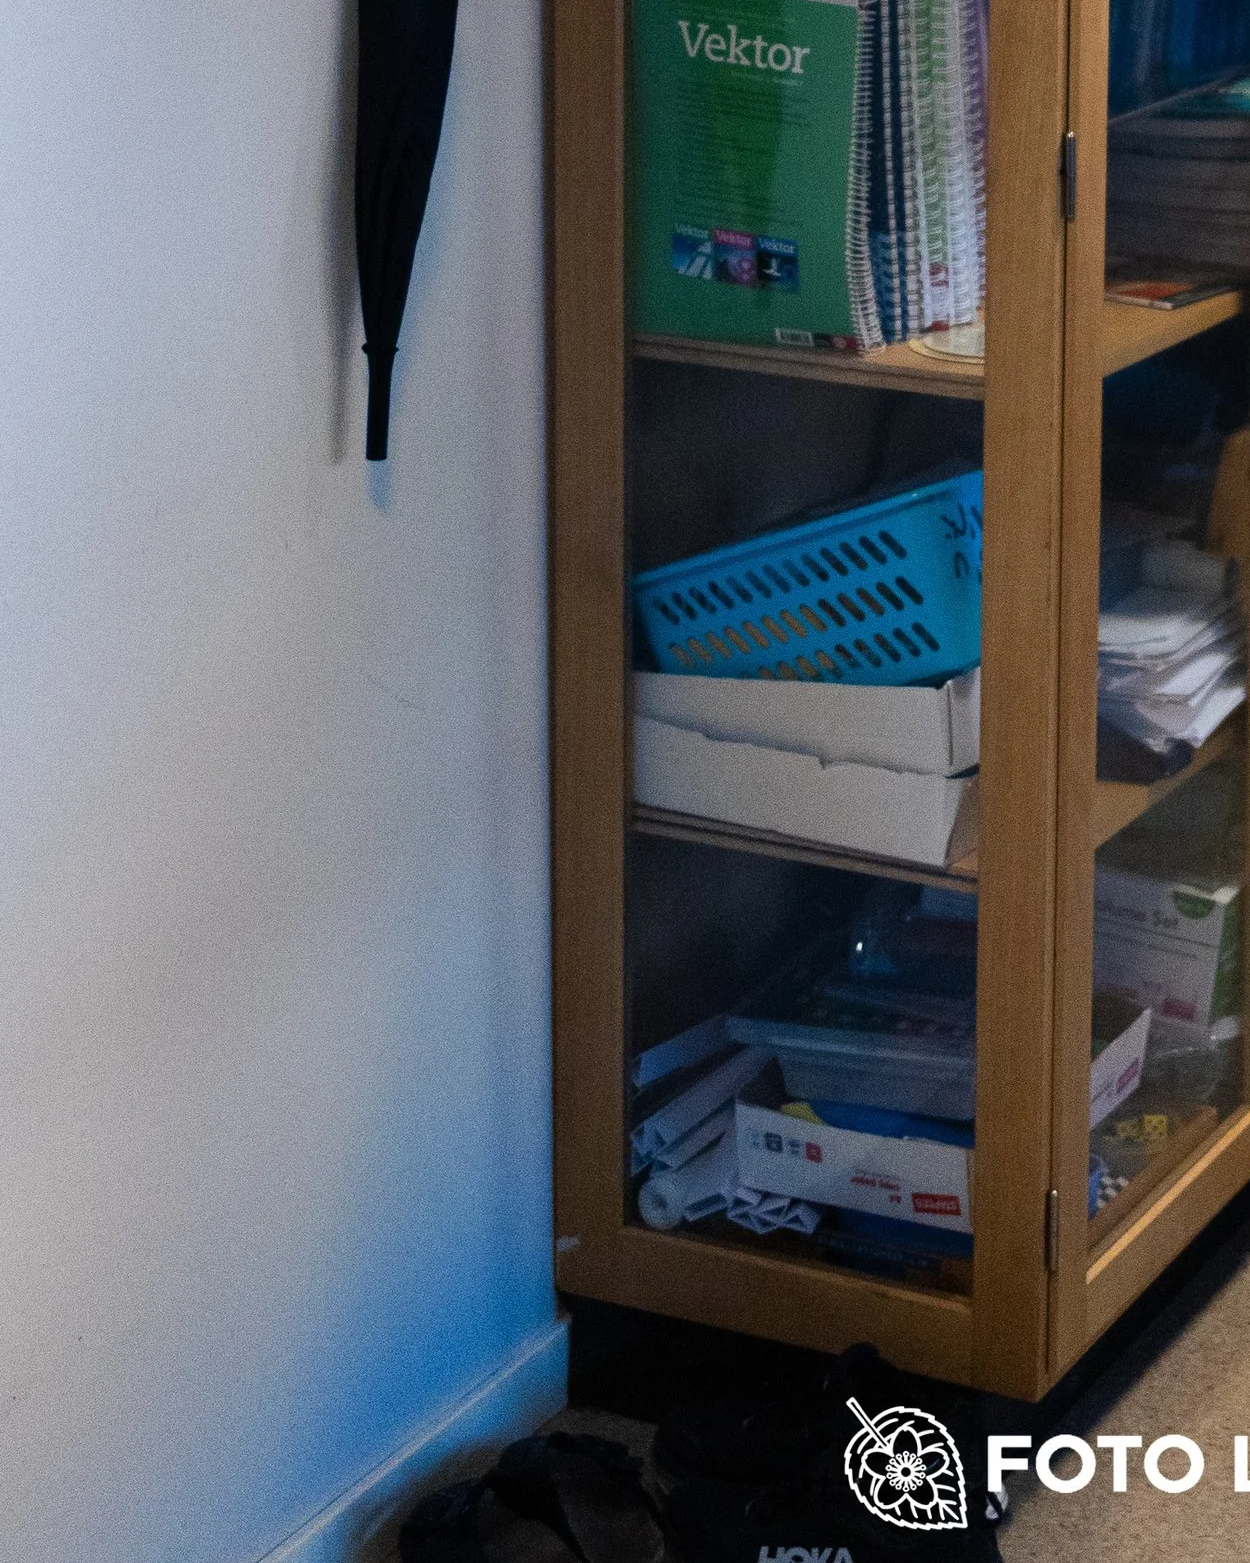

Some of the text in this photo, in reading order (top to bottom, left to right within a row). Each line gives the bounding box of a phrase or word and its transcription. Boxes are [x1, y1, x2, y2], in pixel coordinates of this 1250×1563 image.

[678, 20, 811, 74] Vektor
[675, 222, 709, 239] Vektor
[714, 229, 752, 247] Vektor
[759, 237, 796, 254] Vektor
